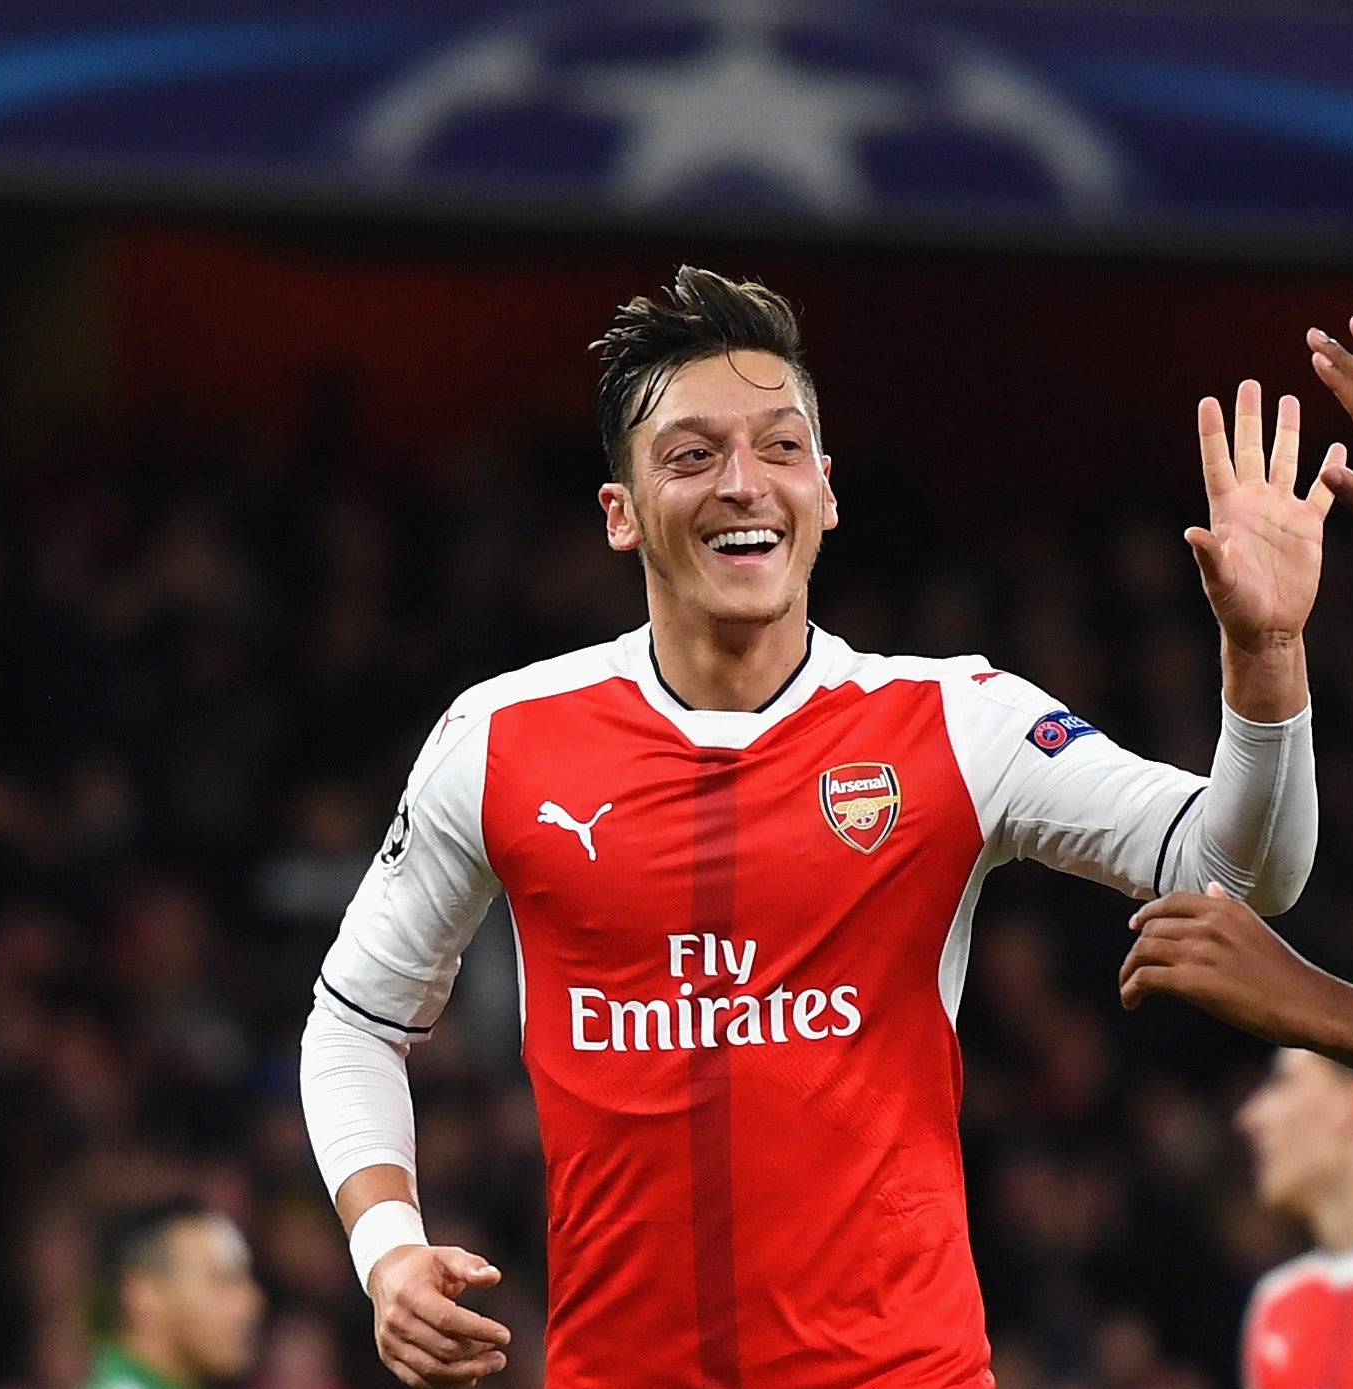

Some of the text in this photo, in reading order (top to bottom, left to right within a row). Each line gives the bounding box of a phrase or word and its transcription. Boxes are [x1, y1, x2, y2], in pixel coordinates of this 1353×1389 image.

[830, 773, 887, 795] Arsenal
[667, 932, 757, 985] Fly
[567, 982, 862, 1052] Emirates
